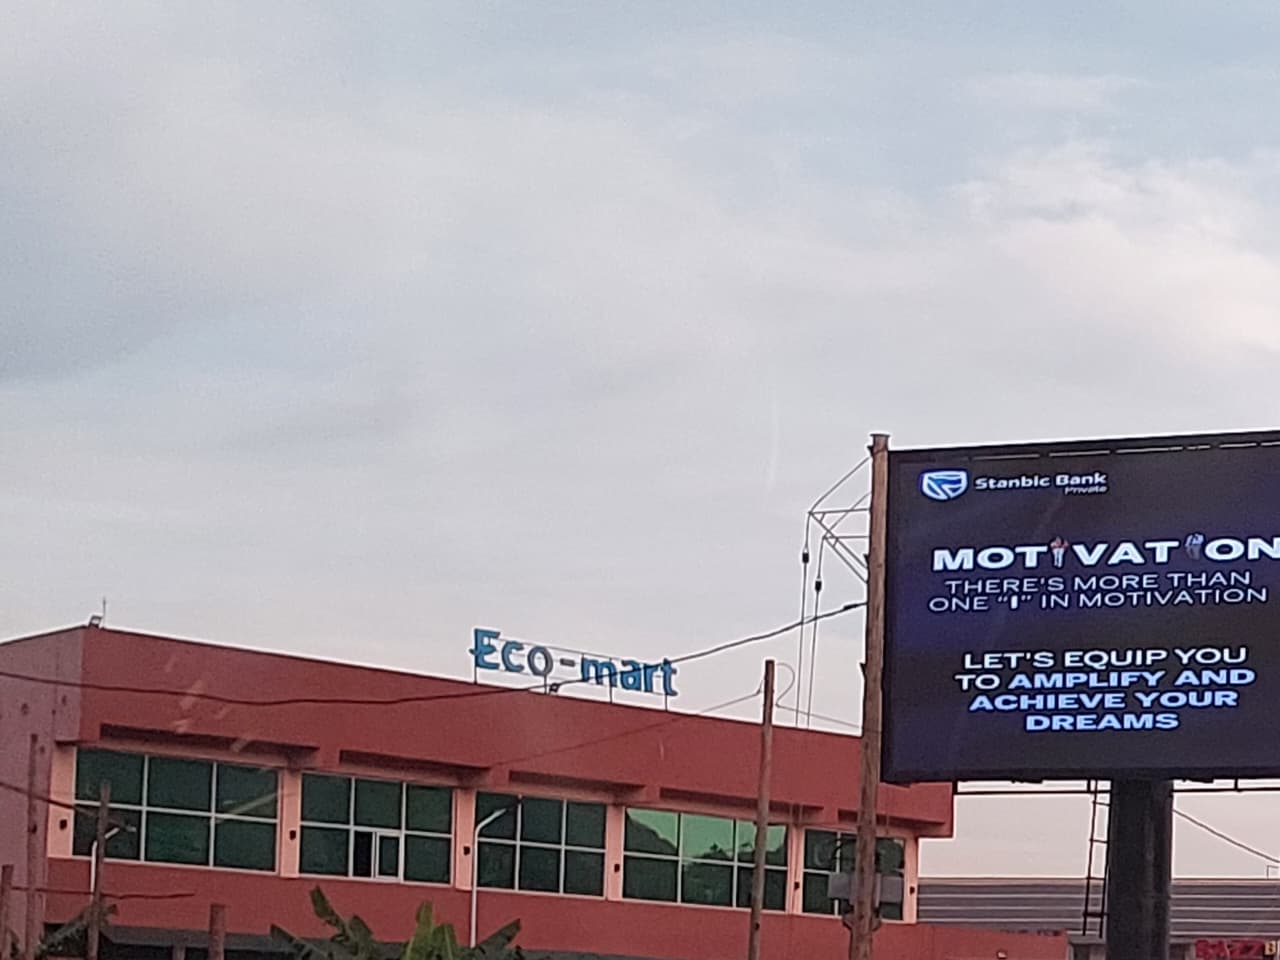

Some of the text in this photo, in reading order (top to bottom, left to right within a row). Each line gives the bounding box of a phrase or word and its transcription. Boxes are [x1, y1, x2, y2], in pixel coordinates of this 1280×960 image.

[975, 473, 1106, 489] Stanbic Bank
[945, 571, 1250, 594] THERE'S MORE THAN
[929, 596, 988, 611] ONE
[1041, 594, 1069, 608] IN
[1079, 588, 1267, 607] MOTIVATION
[470, 627, 678, 696] Eco-mart
[964, 647, 1246, 670] LET'S EQUIP YOU
[955, 669, 1255, 690] TO AMPLIFY AND
[969, 690, 1238, 711] ACHIEVE YOUR
[1026, 713, 1179, 731] DREAMS
